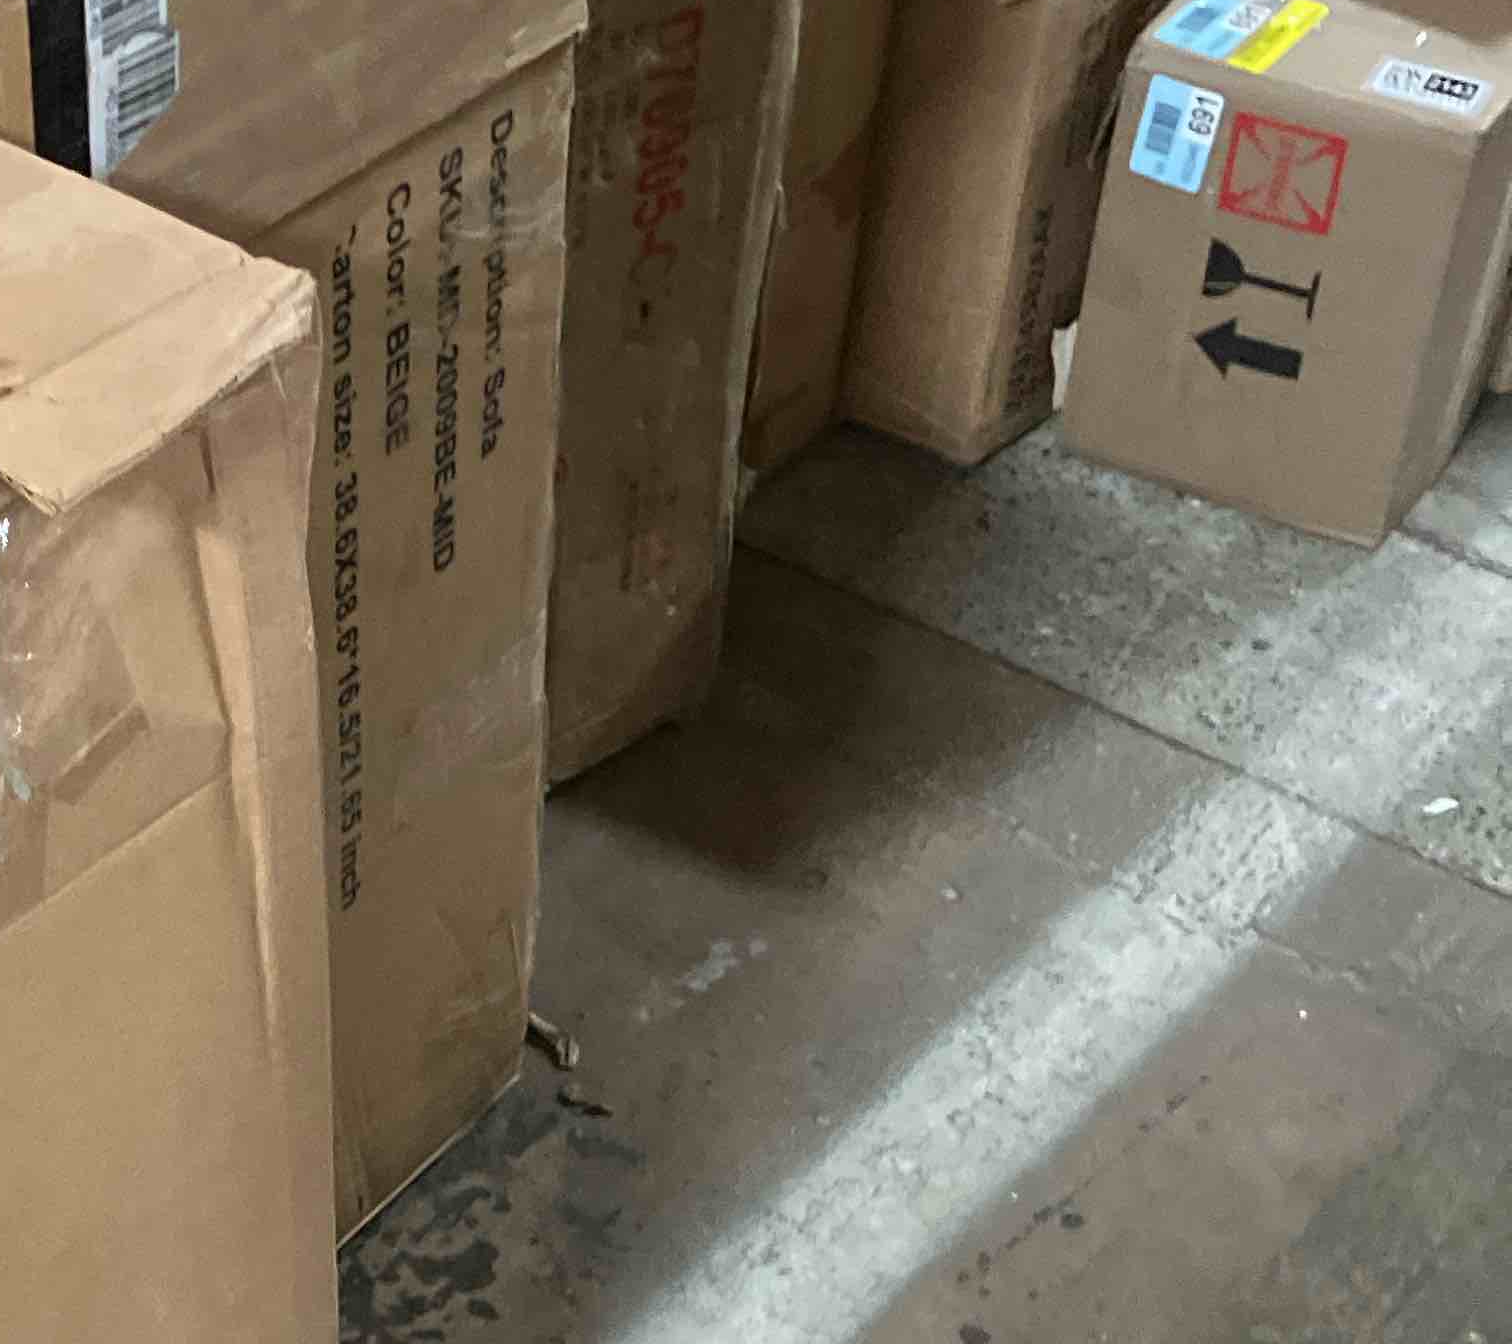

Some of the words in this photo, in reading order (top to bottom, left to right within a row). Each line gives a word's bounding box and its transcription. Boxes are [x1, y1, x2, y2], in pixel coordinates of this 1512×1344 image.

[333, 224, 357, 365] arton
[386, 182, 411, 317] Color:
[482, 108, 514, 362] Descption:
[333, 373, 356, 468] size:
[386, 323, 410, 456] BEIGE
[481, 367, 505, 459] Sofa
[340, 834, 362, 912] inch
